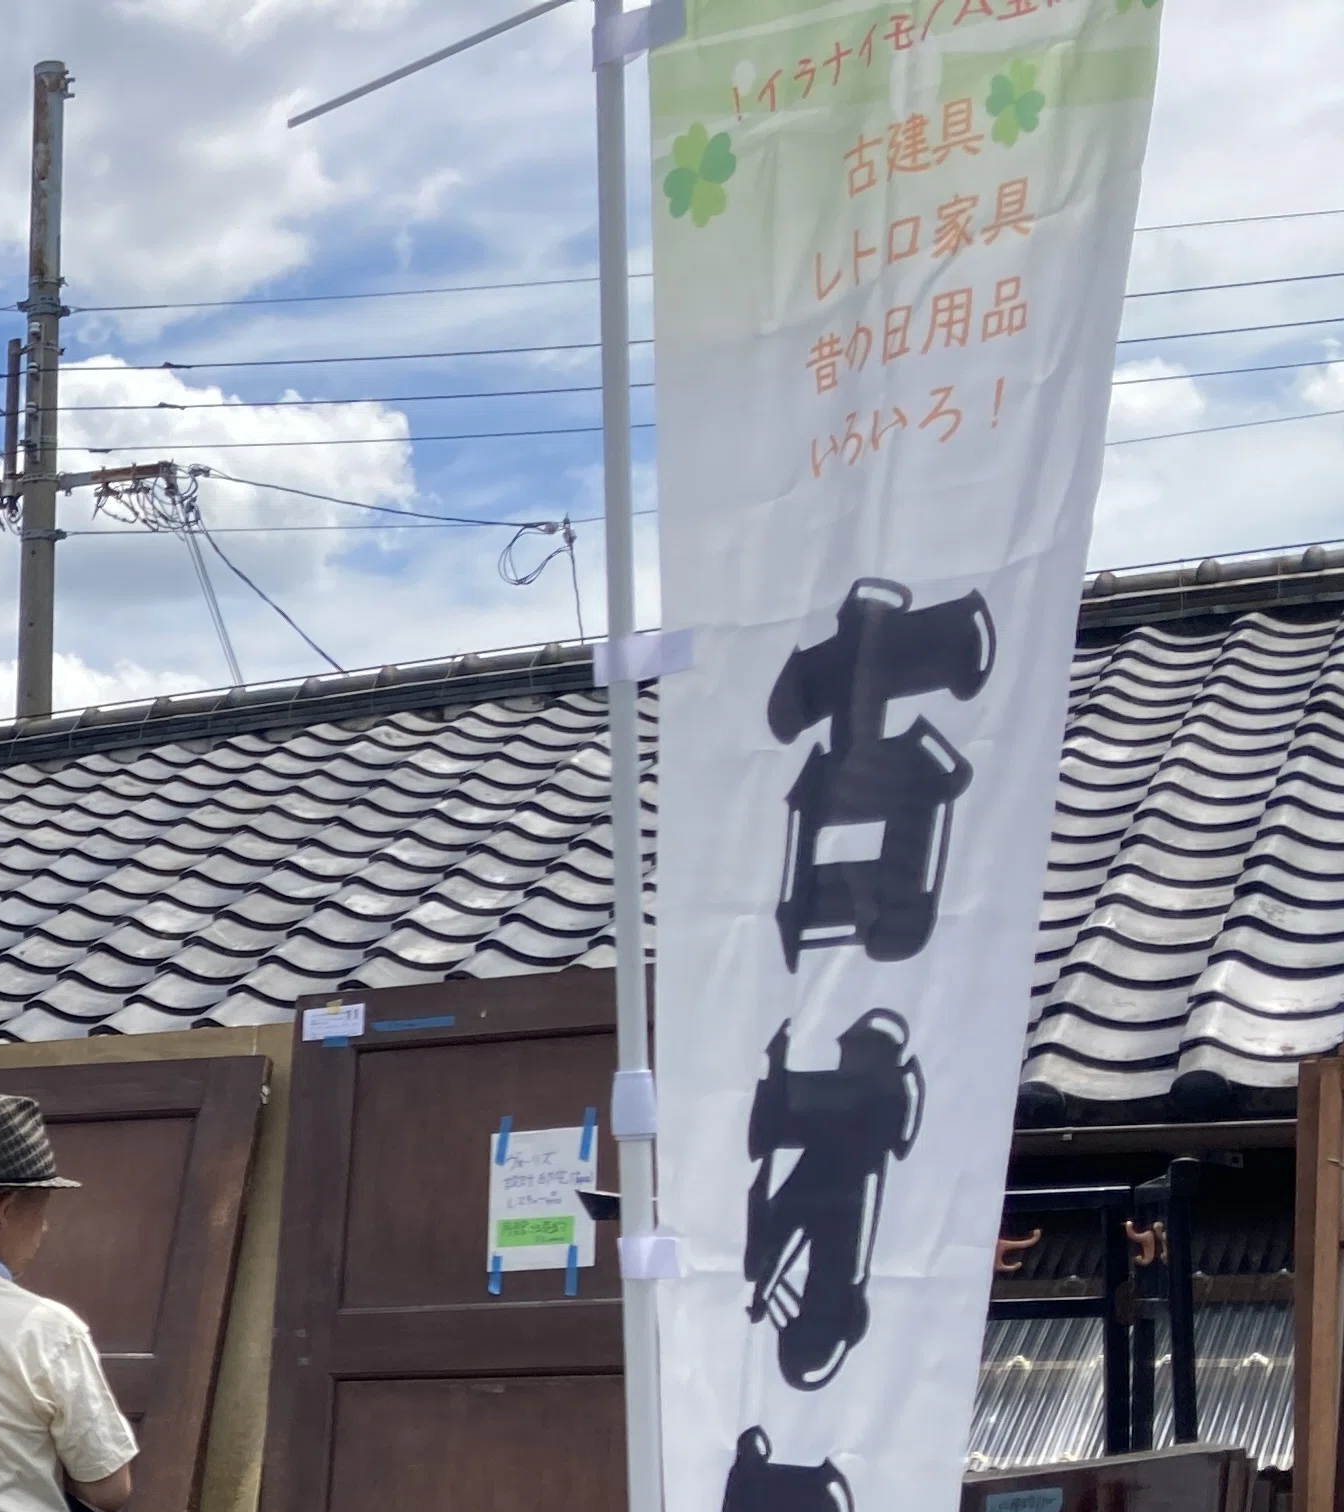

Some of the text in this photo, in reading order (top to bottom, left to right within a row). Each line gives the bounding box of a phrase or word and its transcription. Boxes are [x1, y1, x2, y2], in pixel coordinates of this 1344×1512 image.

[843, 98, 985, 198] 古建具
[814, 177, 1035, 302] レトロ家具
[806, 276, 1028, 395] 昔の日用品
[810, 377, 1005, 479] いろいろ！
